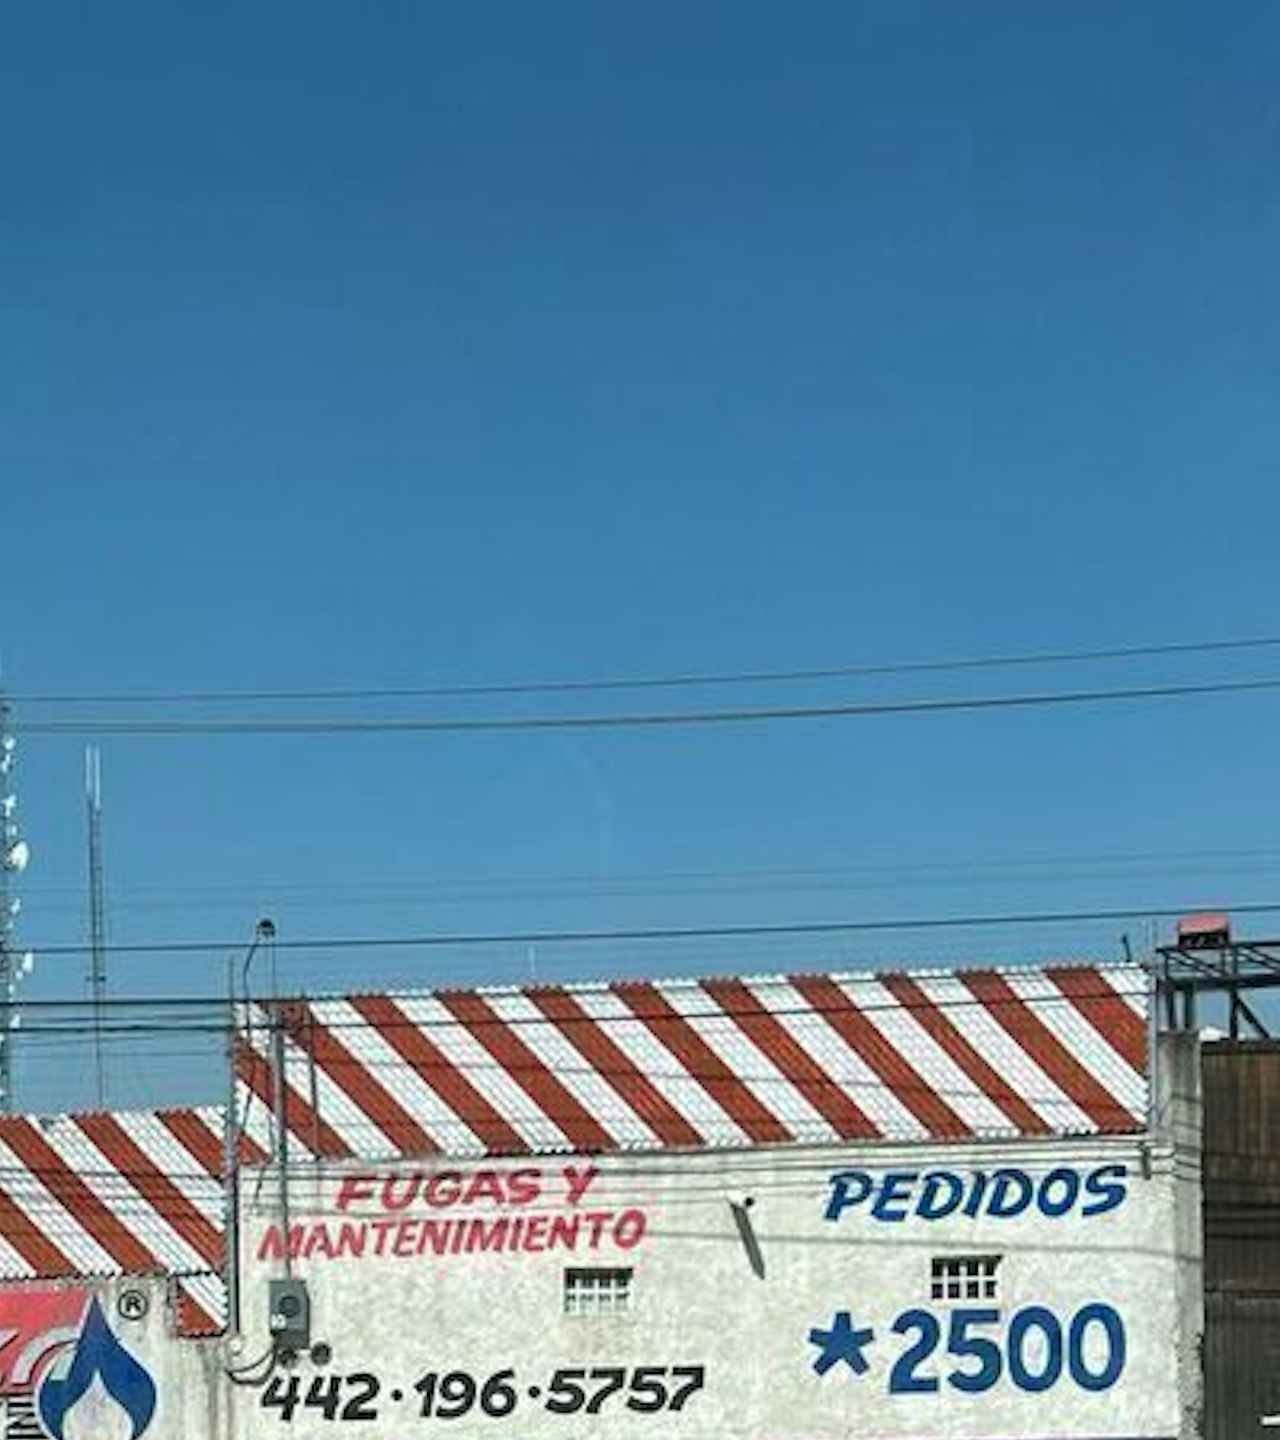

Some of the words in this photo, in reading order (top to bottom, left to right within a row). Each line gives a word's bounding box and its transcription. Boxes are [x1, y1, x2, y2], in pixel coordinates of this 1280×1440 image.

[335, 1168, 543, 1212] FUGAS
[561, 1165, 603, 1205] Y
[823, 1165, 1128, 1222] PEDIDOS
[256, 1208, 649, 1262] MANTENIMIENTO
